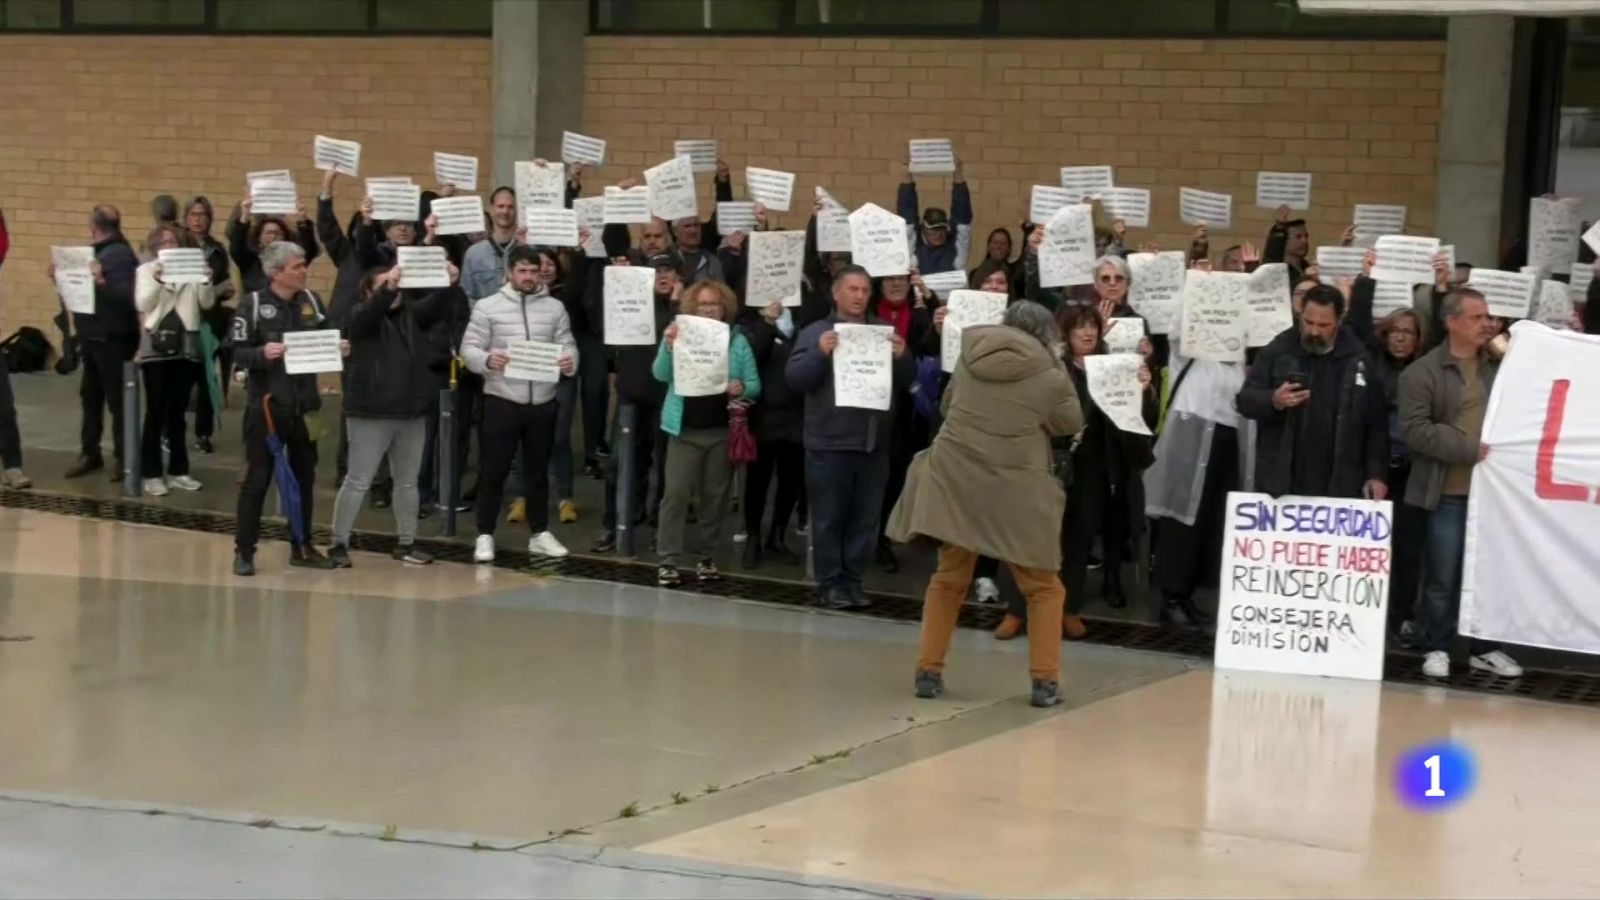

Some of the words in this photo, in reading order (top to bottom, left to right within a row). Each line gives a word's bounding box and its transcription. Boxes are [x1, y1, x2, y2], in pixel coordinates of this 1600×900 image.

[1234, 501, 1277, 531] SIN
[1281, 505, 1392, 541] SEGURIDAD
[1233, 537, 1265, 561] NO
[1271, 540, 1332, 567] PUEDE
[1337, 546, 1390, 575] HABER
[1231, 605, 1355, 634] CONSEJERA
